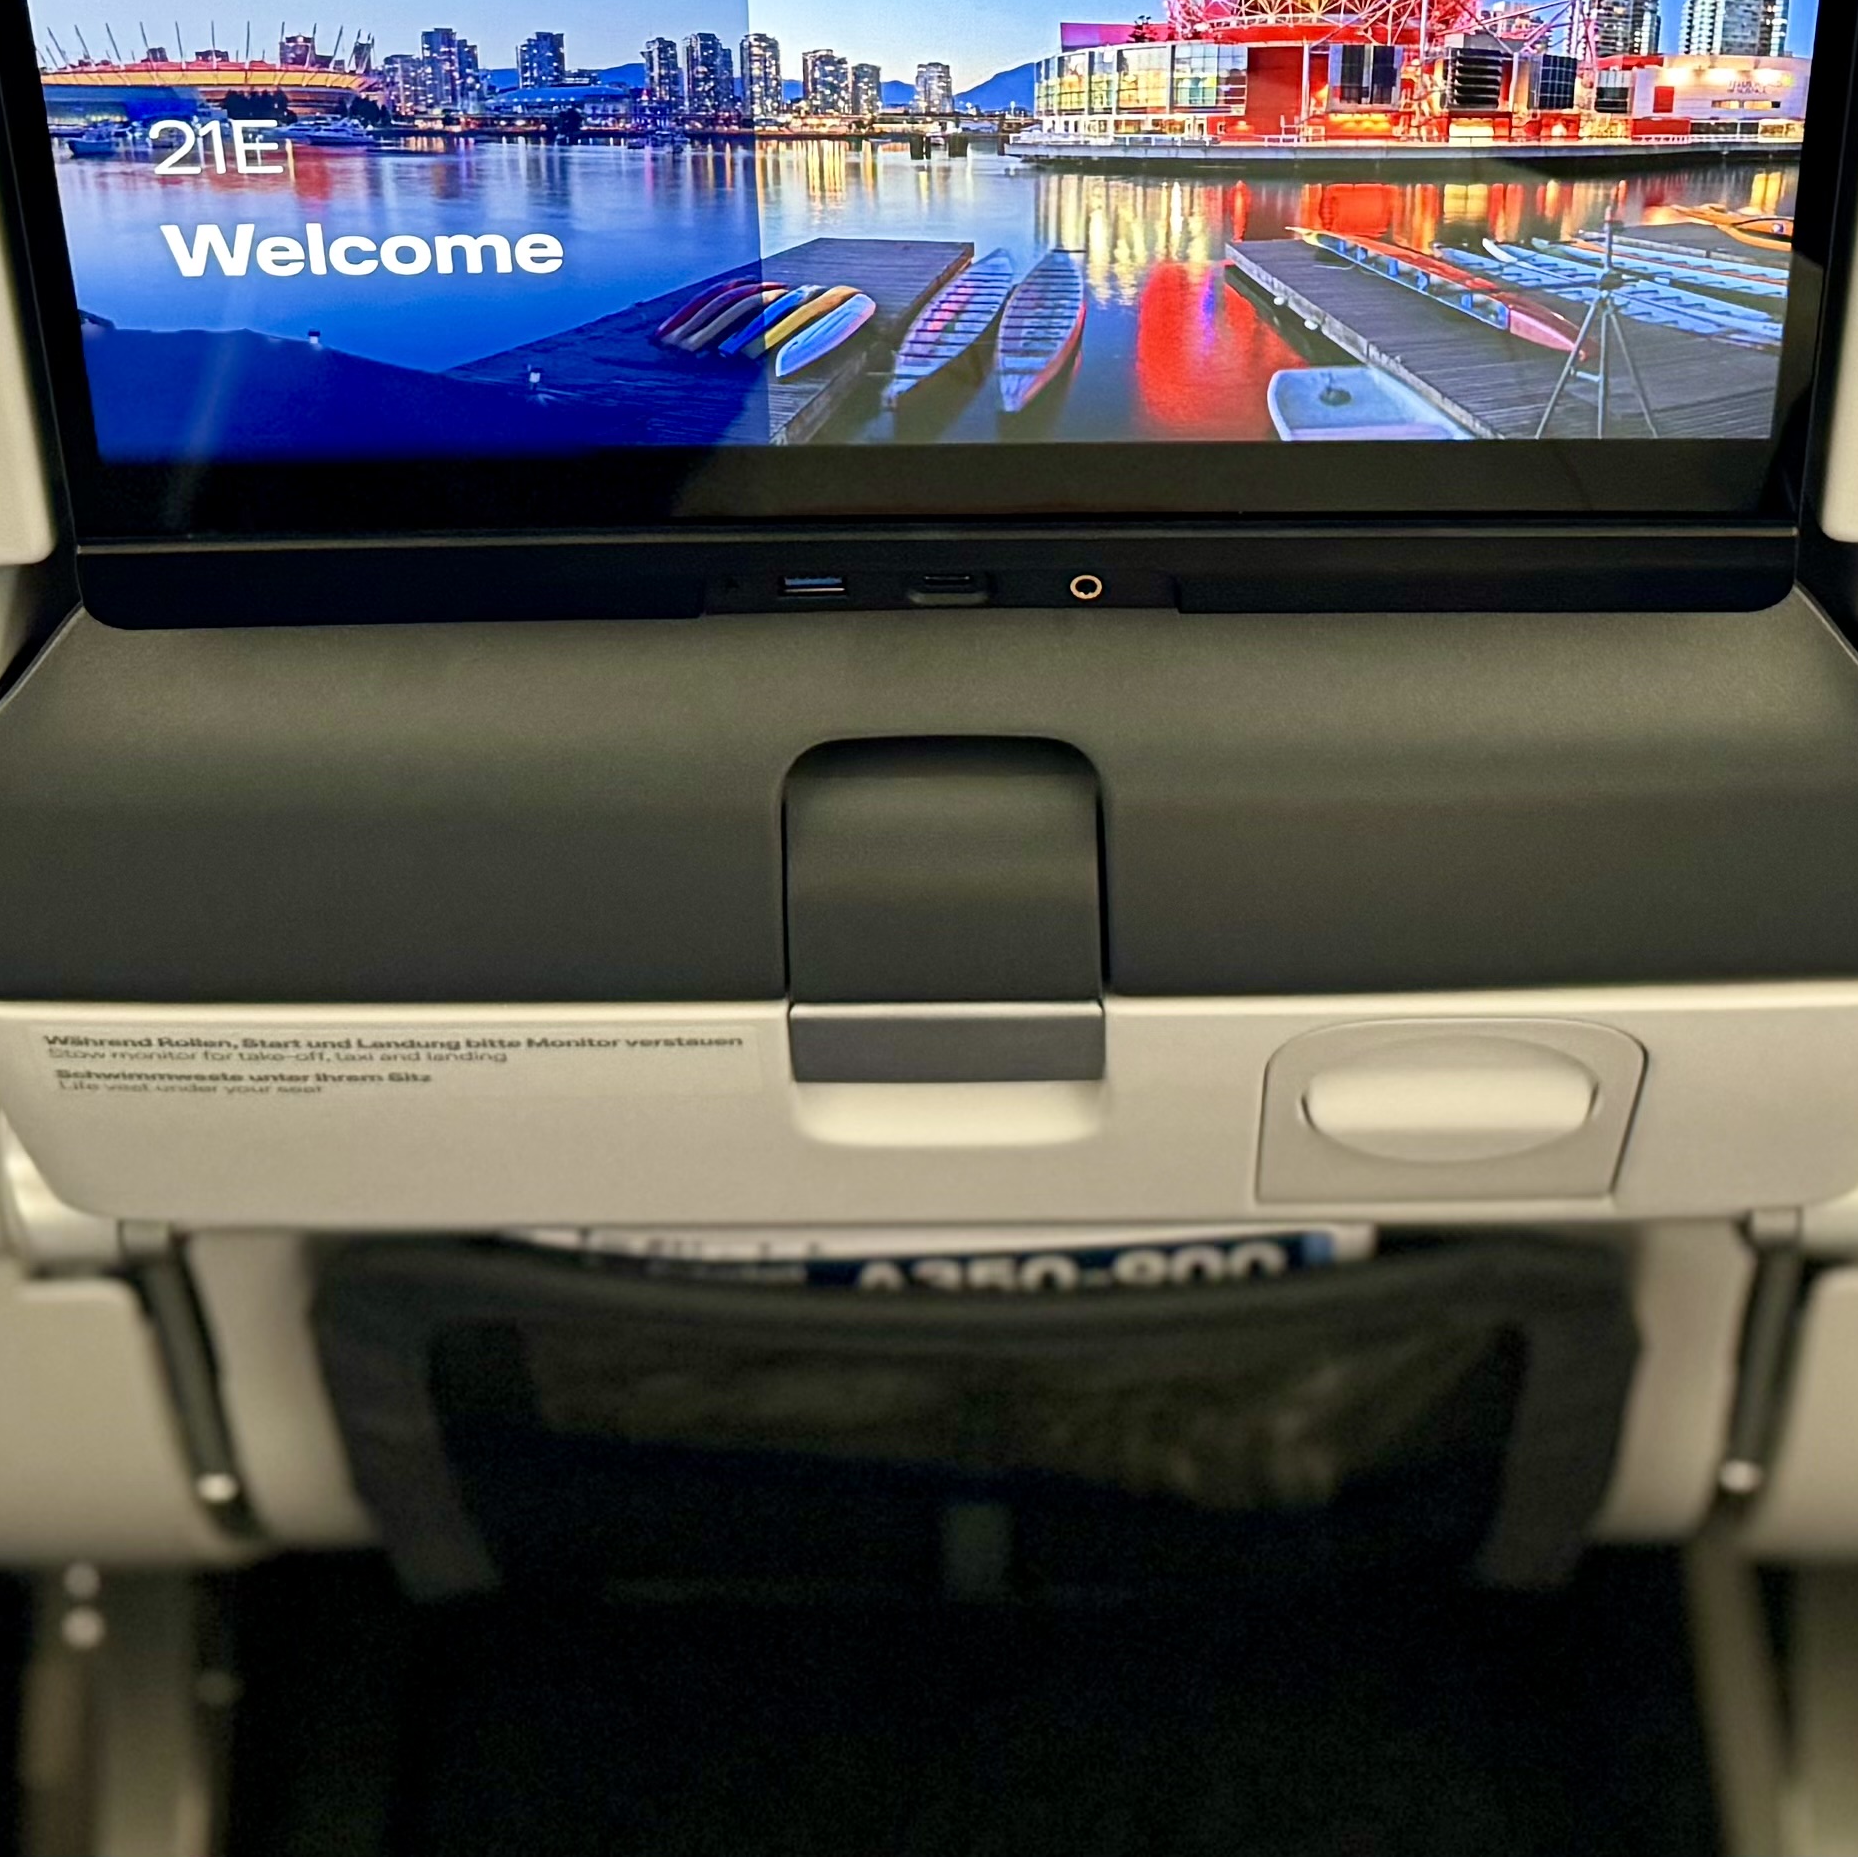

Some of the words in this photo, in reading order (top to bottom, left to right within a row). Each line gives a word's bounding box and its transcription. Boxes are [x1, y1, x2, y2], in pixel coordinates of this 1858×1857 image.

[148, 118, 285, 176] 21E
[159, 222, 565, 278] Welcome
[43, 1034, 153, 1047] Während
[157, 1037, 239, 1050] Rollen,
[242, 1038, 302, 1049] Start
[306, 1039, 352, 1049] und
[357, 1038, 461, 1052] Landung
[465, 1038, 522, 1049] bitte
[526, 1037, 622, 1049] Monitor
[625, 1036, 744, 1048] verstauen
